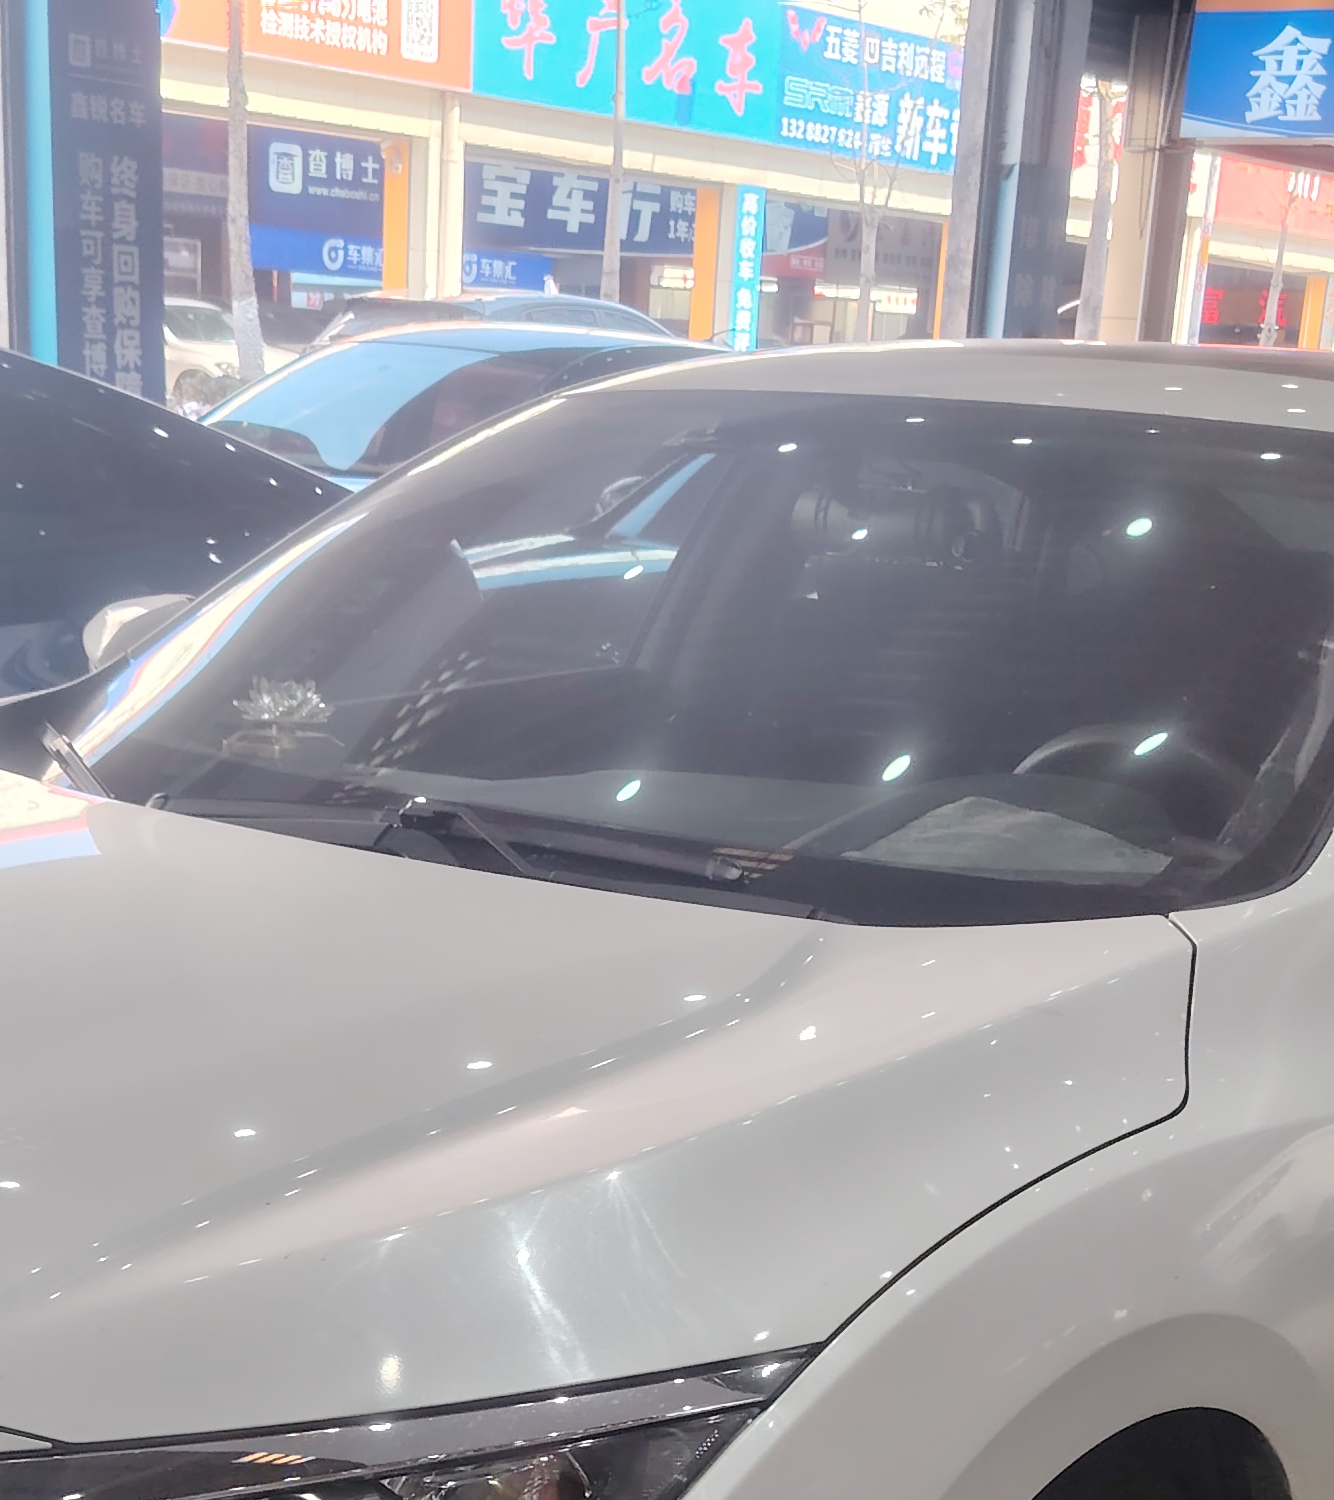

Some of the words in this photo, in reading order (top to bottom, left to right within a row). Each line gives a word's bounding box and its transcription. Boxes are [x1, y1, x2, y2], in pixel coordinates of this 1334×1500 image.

[260, 8, 389, 57] 检测技术授权机构
[824, 25, 860, 65] 五菱
[880, 36, 947, 83] 吉利远程
[308, 148, 380, 184] 查博士
[476, 162, 661, 243] 宝车行
